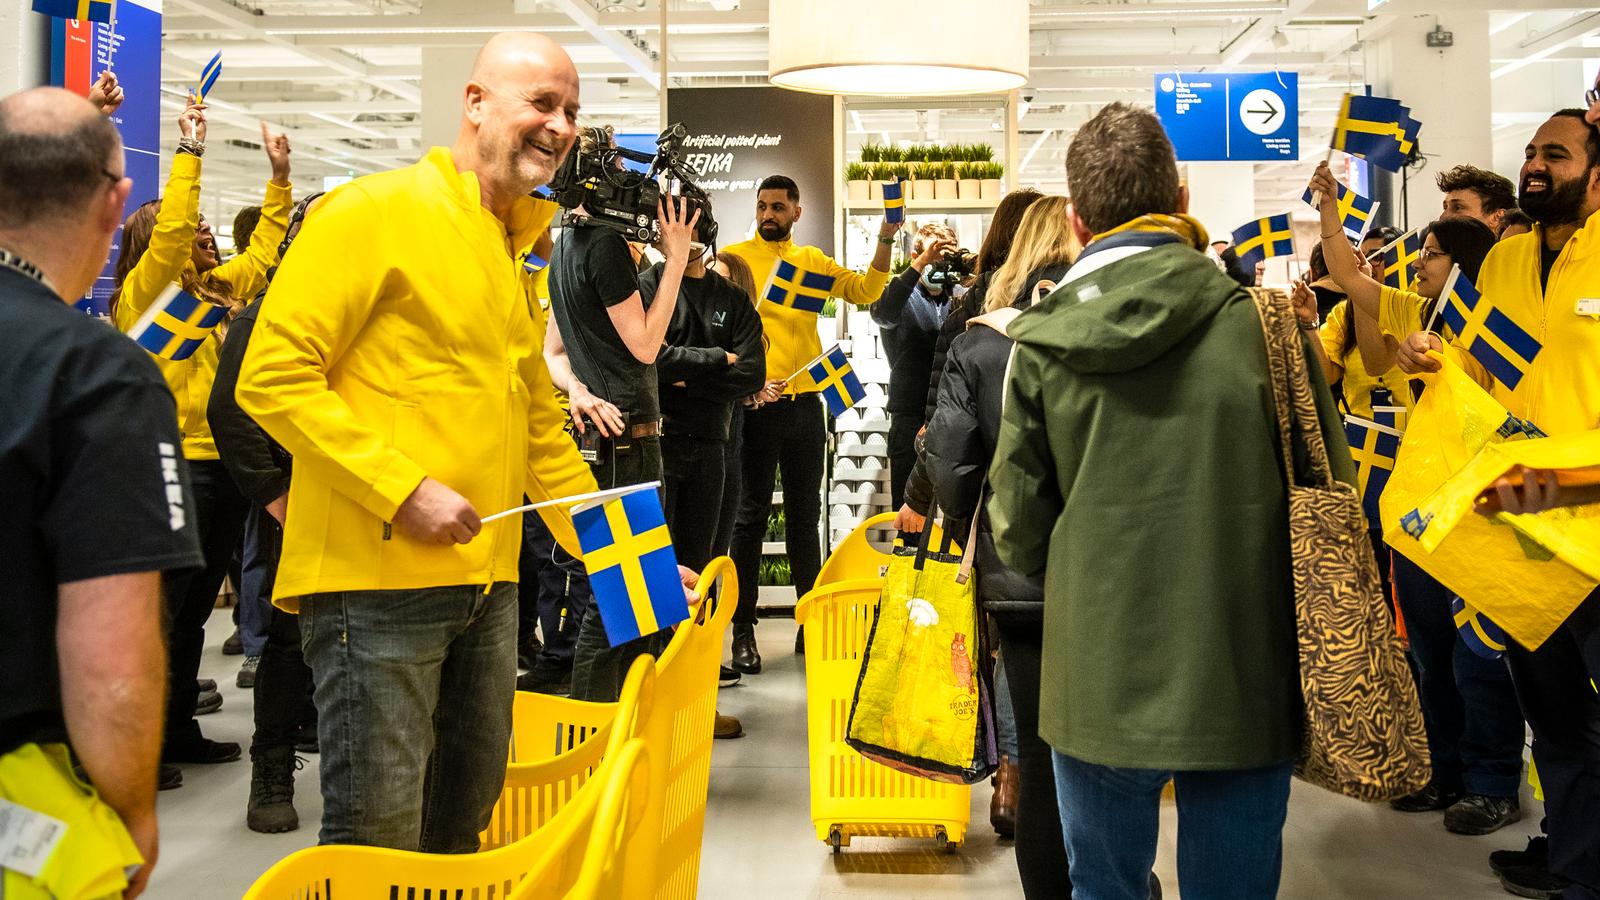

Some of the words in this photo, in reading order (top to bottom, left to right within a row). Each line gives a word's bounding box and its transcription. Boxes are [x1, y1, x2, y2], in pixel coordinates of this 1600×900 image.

[682, 134, 725, 150] Artificial
[723, 134, 757, 149] potted
[753, 134, 782, 149] plant
[158, 442, 186, 531] IKEA
[950, 700, 977, 710] TRADER
[953, 707, 975, 716] JOE'S
